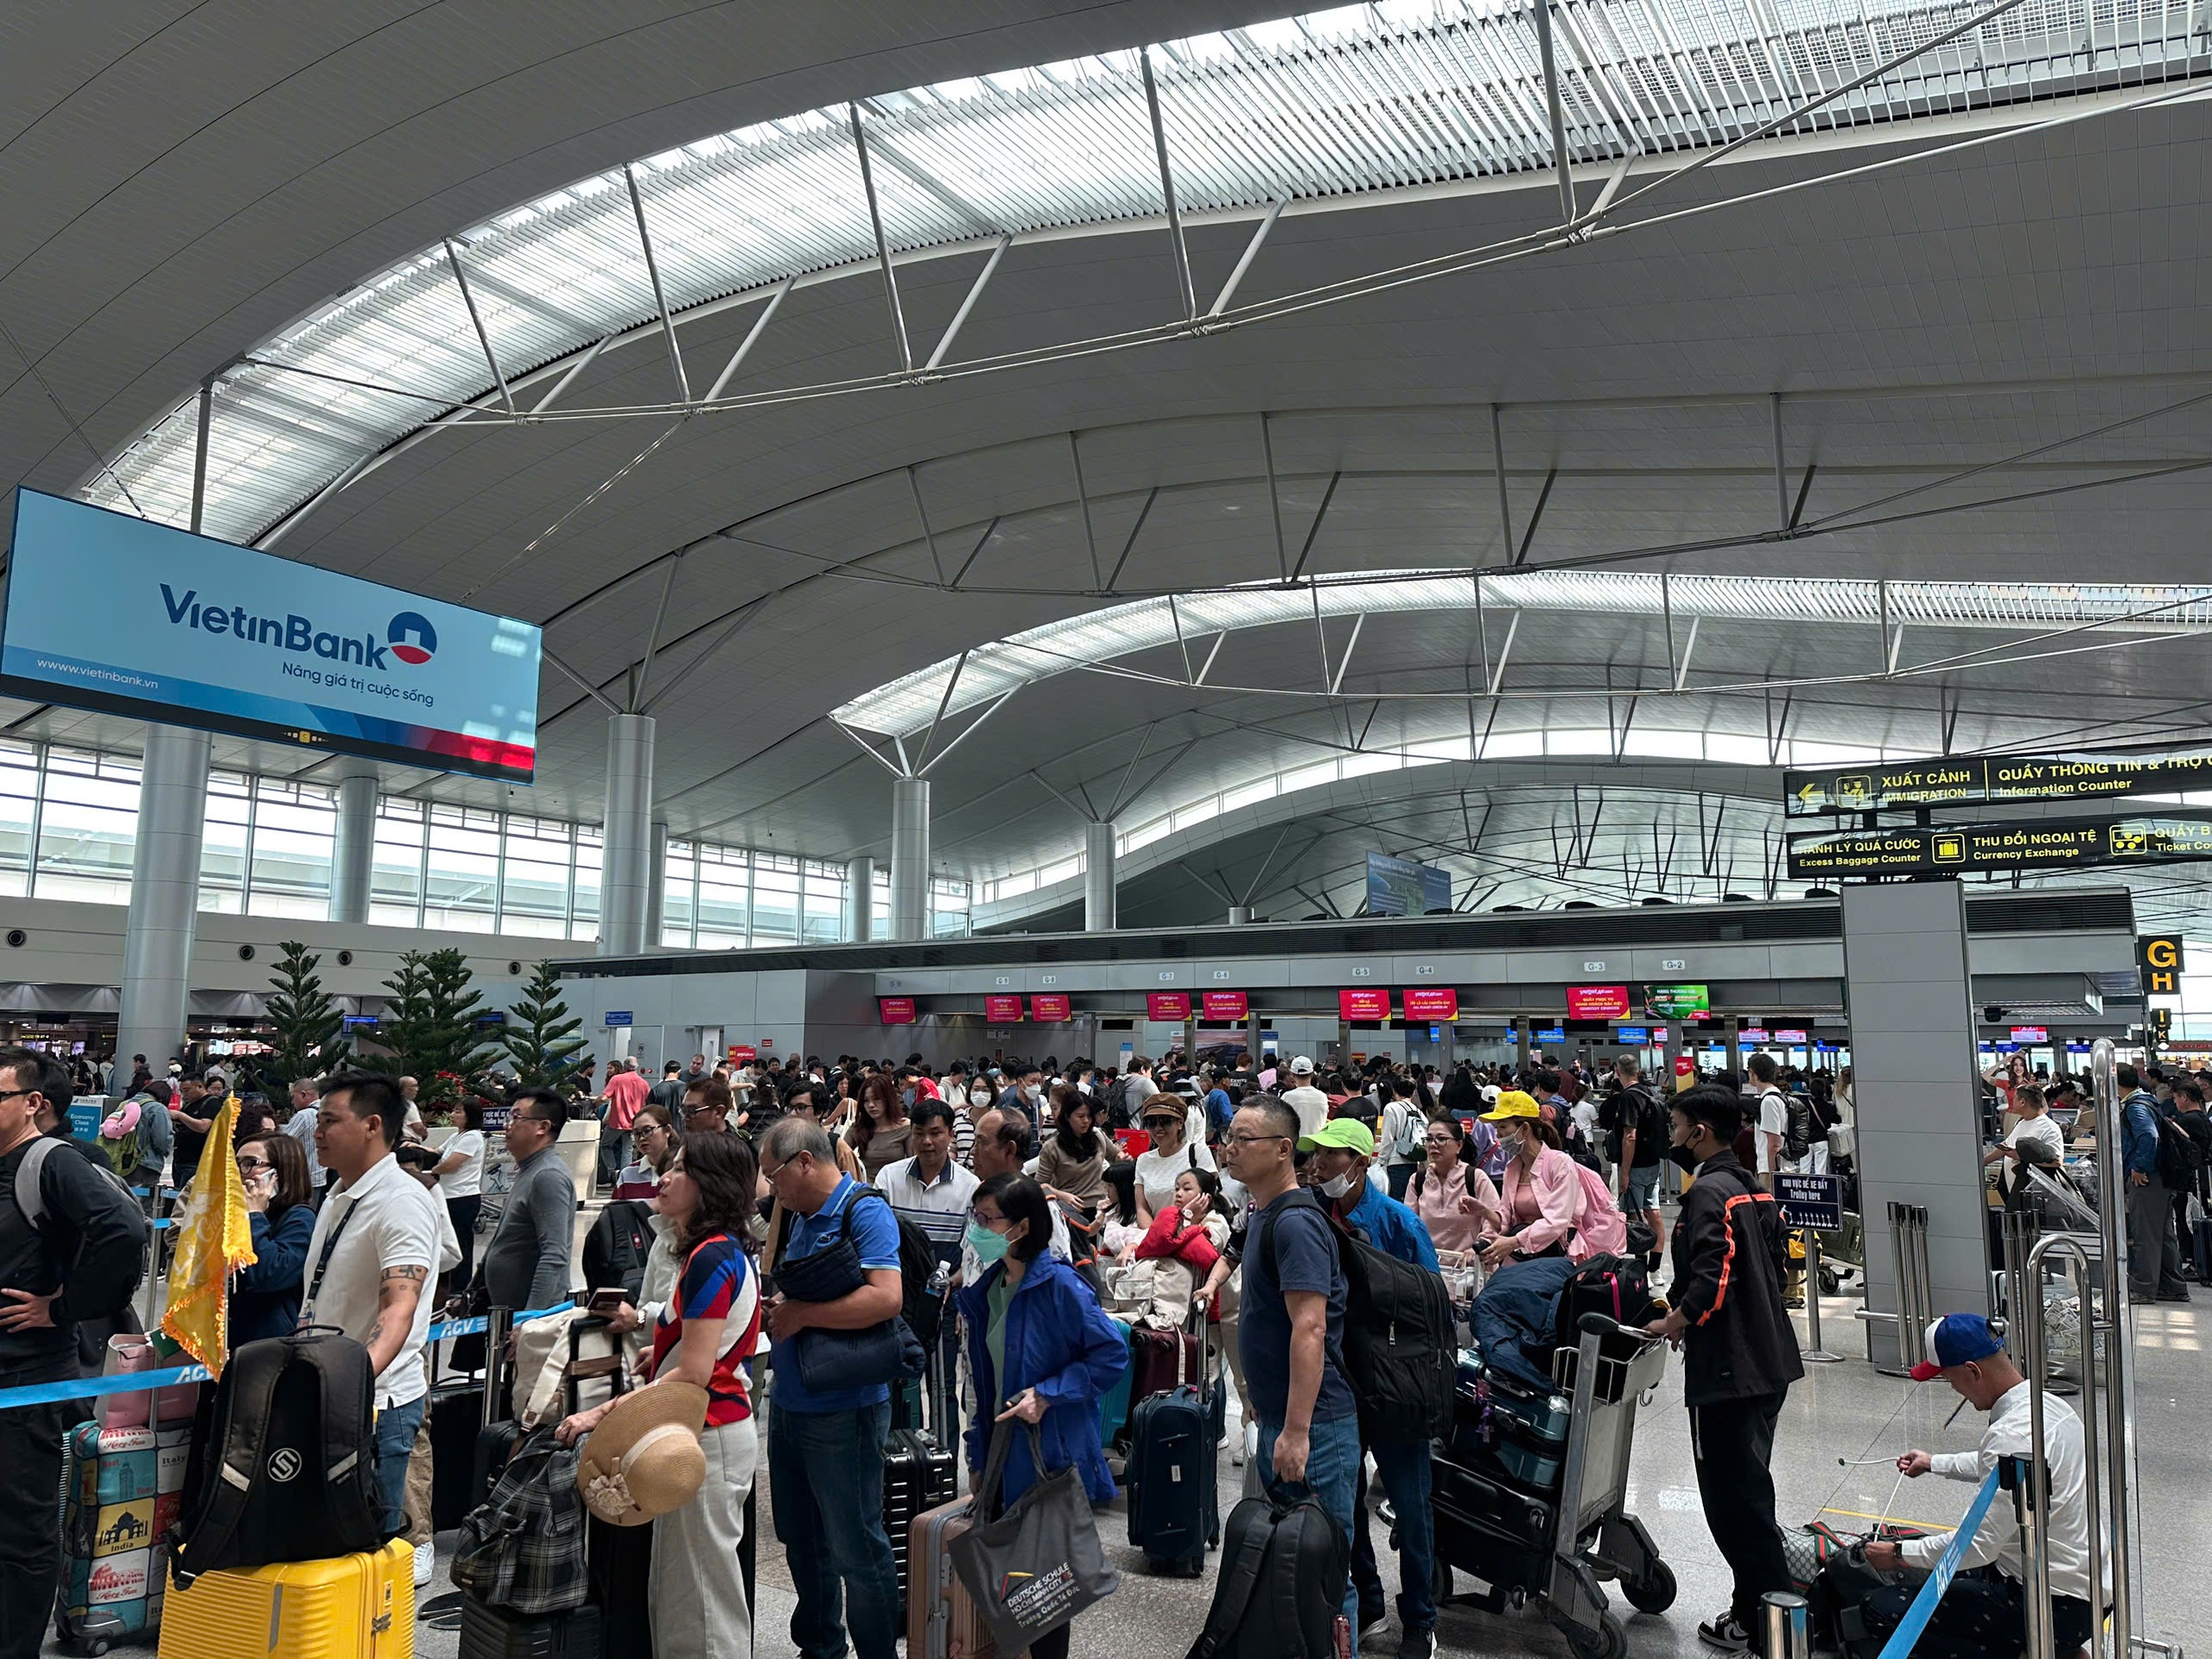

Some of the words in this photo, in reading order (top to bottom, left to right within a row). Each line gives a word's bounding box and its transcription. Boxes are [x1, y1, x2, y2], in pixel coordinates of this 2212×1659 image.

[158, 582, 388, 671] VietinBank
[282, 661, 321, 684] Nâng
[325, 672, 347, 687] giá
[350, 677, 365, 694] trị
[367, 683, 400, 699] cuộc
[403, 689, 435, 708] sống
[1998, 763, 2044, 781] QUẦY
[2049, 760, 2109, 777] THÔNG
[2113, 760, 2142, 772] TIN
[2147, 759, 2159, 770] &
[2164, 753, 2202, 769] TRỢ
[1882, 770, 1923, 788] XUẤT
[1926, 768, 1971, 785] CẢNH
[1882, 788, 1967, 803] IMMIGRATION
[1999, 783, 2075, 796] Information
[2077, 779, 2133, 791] Counter
[1973, 836, 2000, 847] THU
[2004, 830, 2027, 846] ĐỔI
[2031, 832, 2075, 845] NGOẠI
[2078, 829, 2097, 843] TỆ
[2154, 823, 2196, 838] QUẦY
[1836, 839, 1851, 853] LÝ
[1854, 839, 1882, 852] QUÁ
[1884, 837, 1921, 851] CƯỚC
[2155, 842, 2191, 852] Ticket
[1799, 858, 1834, 868] Excess
[1836, 855, 1879, 866] Baggage
[1881, 851, 1921, 862] Counter
[1974, 850, 2022, 861] Currency
[2024, 848, 2079, 858] Exchange
[2146, 940, 2177, 968] G
[2152, 972, 2172, 991] H
[2158, 1029, 2166, 1039] K
[70, 1113, 95, 1122] Economy
[441, 1319, 475, 1338] ACV
[162, 1454, 187, 1465] Italy
[111, 1541, 134, 1553] India
[1007, 1580, 1044, 1608] DEUTSCHE
[1042, 1562, 1070, 1585] SCHULE
